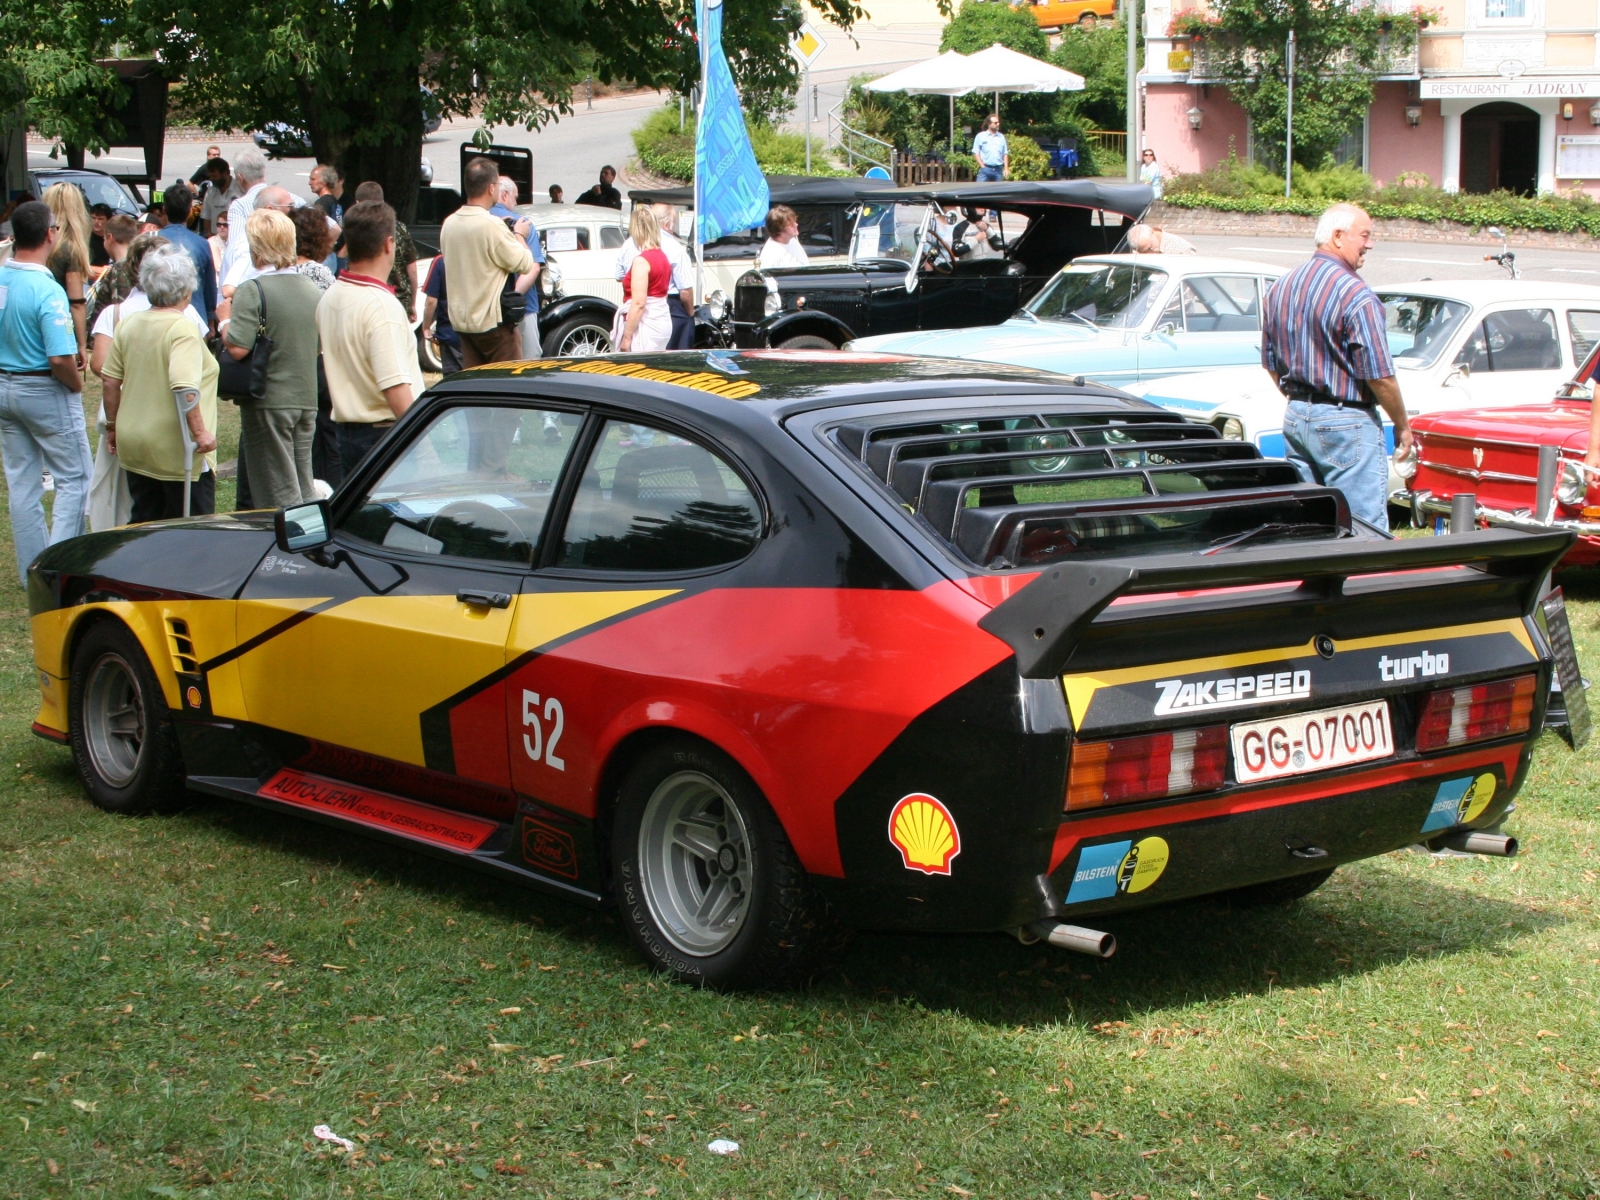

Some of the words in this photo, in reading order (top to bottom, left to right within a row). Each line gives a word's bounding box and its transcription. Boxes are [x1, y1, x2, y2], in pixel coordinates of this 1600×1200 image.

[1431, 84, 1509, 95] RESTAURANT
[1523, 83, 1588, 95] JADRAN
[1379, 650, 1449, 682] turbo
[1154, 670, 1311, 716] ZAKSPEED
[522, 688, 565, 772] 52
[1242, 707, 1388, 774] GG-07001
[271, 777, 363, 810] AUTO-LIEHN
[390, 814, 477, 843] GEBRAUCHTWAGEN
[1431, 798, 1460, 813] BILSTEIN
[534, 832, 563, 860] Ford
[1075, 865, 1118, 882] BILSTEIN
[622, 858, 701, 976] YOKOHAMA
